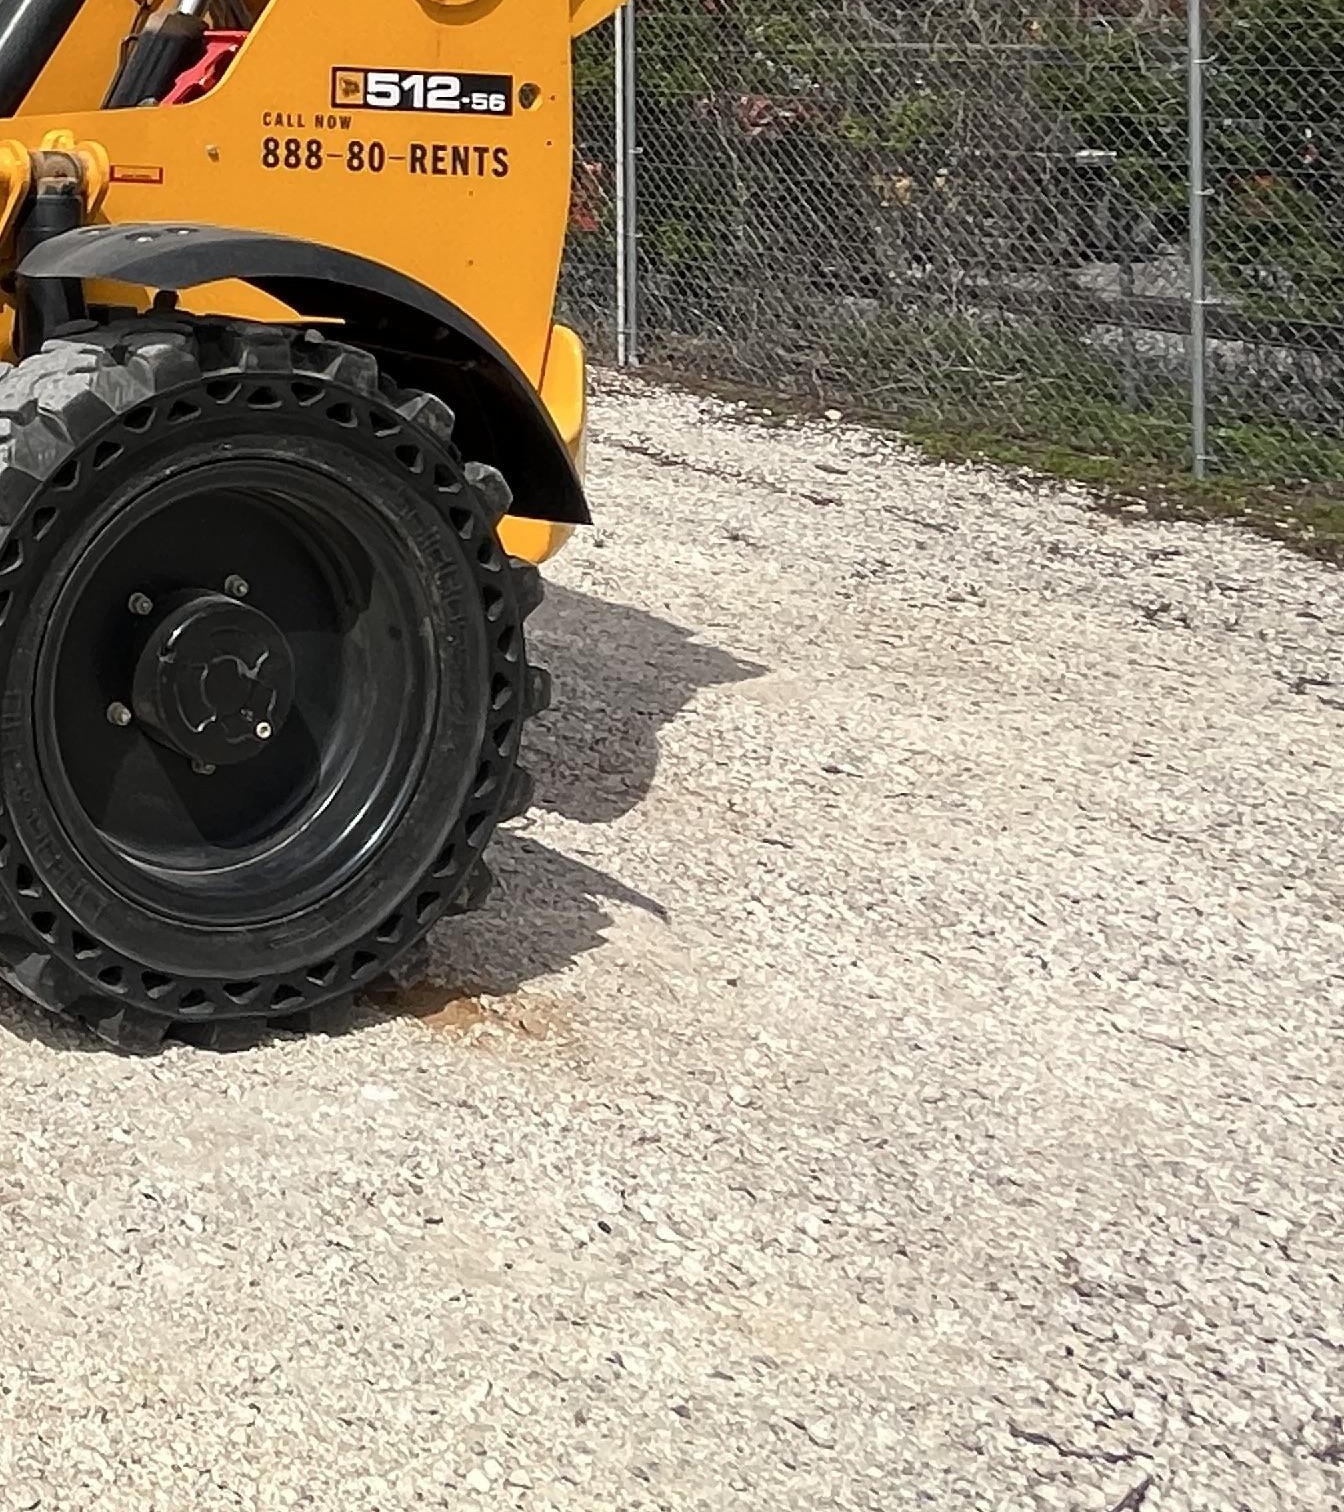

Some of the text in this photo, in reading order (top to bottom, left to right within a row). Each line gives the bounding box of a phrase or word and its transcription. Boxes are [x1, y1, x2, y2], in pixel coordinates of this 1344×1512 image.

[262, 111, 352, 130] CALL NOW
[261, 136, 510, 178] 888-80-RENTS
